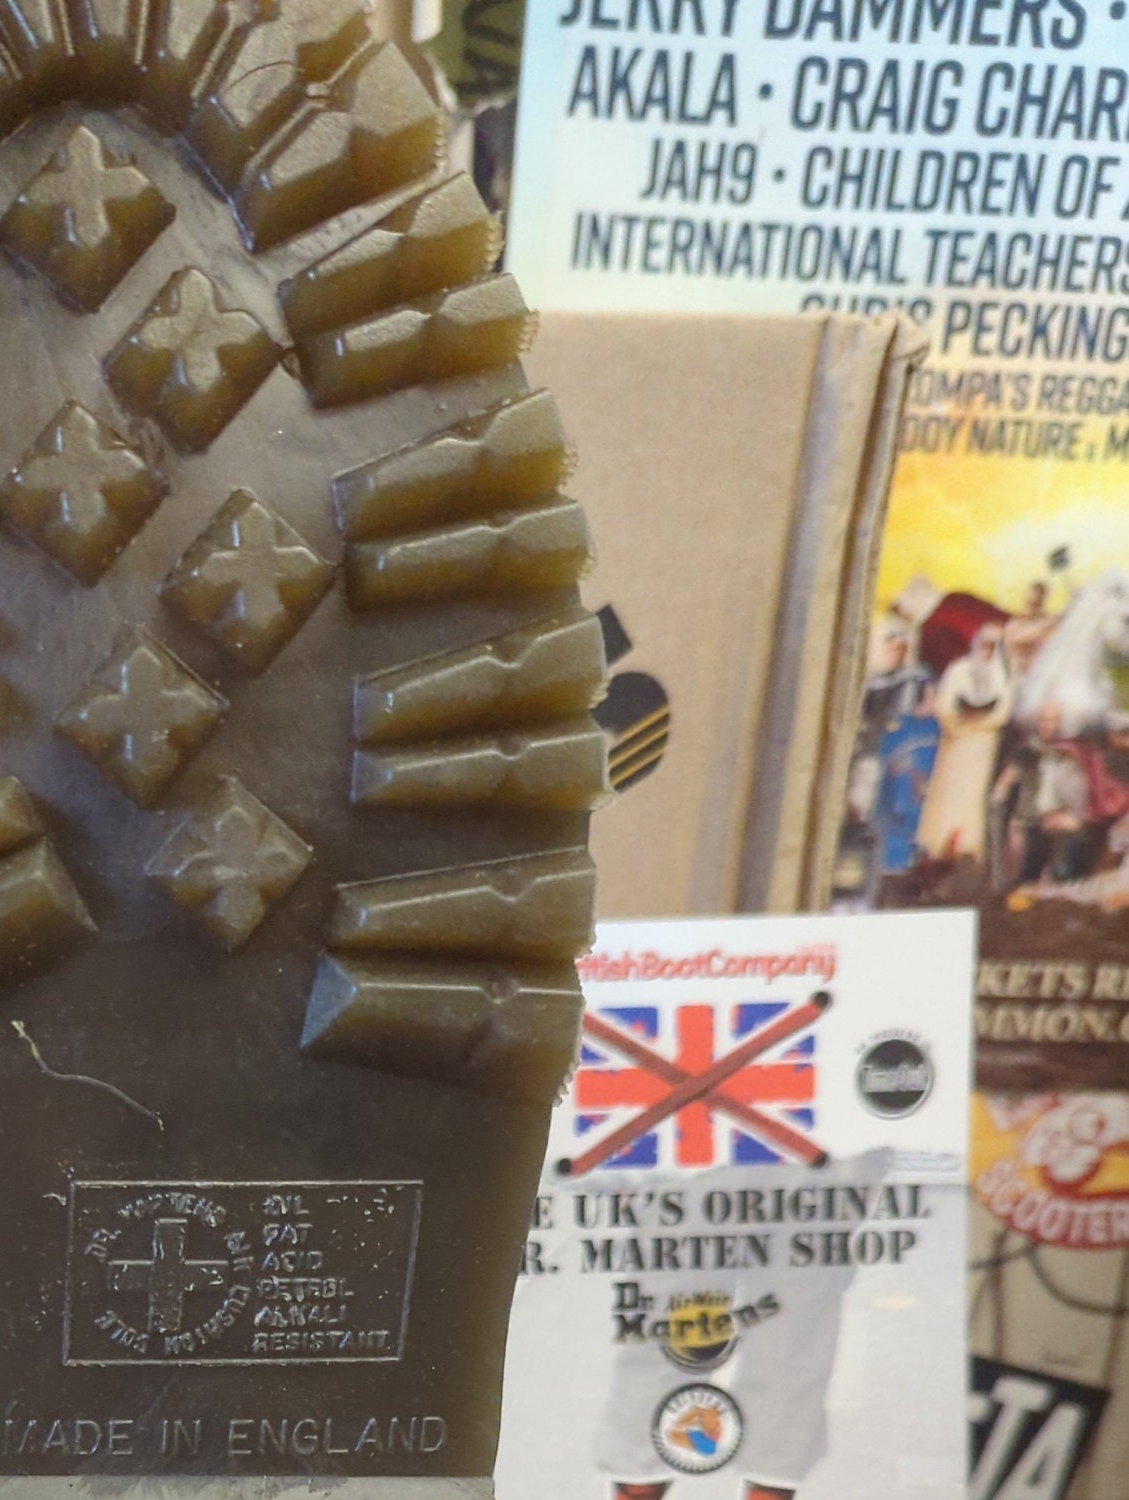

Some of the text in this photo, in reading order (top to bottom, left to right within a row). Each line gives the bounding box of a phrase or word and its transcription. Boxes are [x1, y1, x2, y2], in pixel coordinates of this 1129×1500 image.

[567, 44, 1129, 143] AKALA CRAIG CHAR
[641, 139, 1120, 220] JAH9 CHILDREN OF
[571, 213, 908, 287] INTERNATIONAL
[975, 960, 1089, 999] KETS
[571, 1191, 683, 1228] UK'S
[702, 1184, 930, 1225] ORIGINAL
[261, 1251, 323, 1272] ACID
[520, 1230, 917, 1274] R. MARTEN SHOP
[256, 1277, 354, 1301] PETROL
[254, 1305, 348, 1327] ALKALI
[613, 1293, 781, 1343] Martens
[253, 1330, 390, 1352] RESISTANT
[3, 1417, 448, 1456] MADE IN ENGLAND
